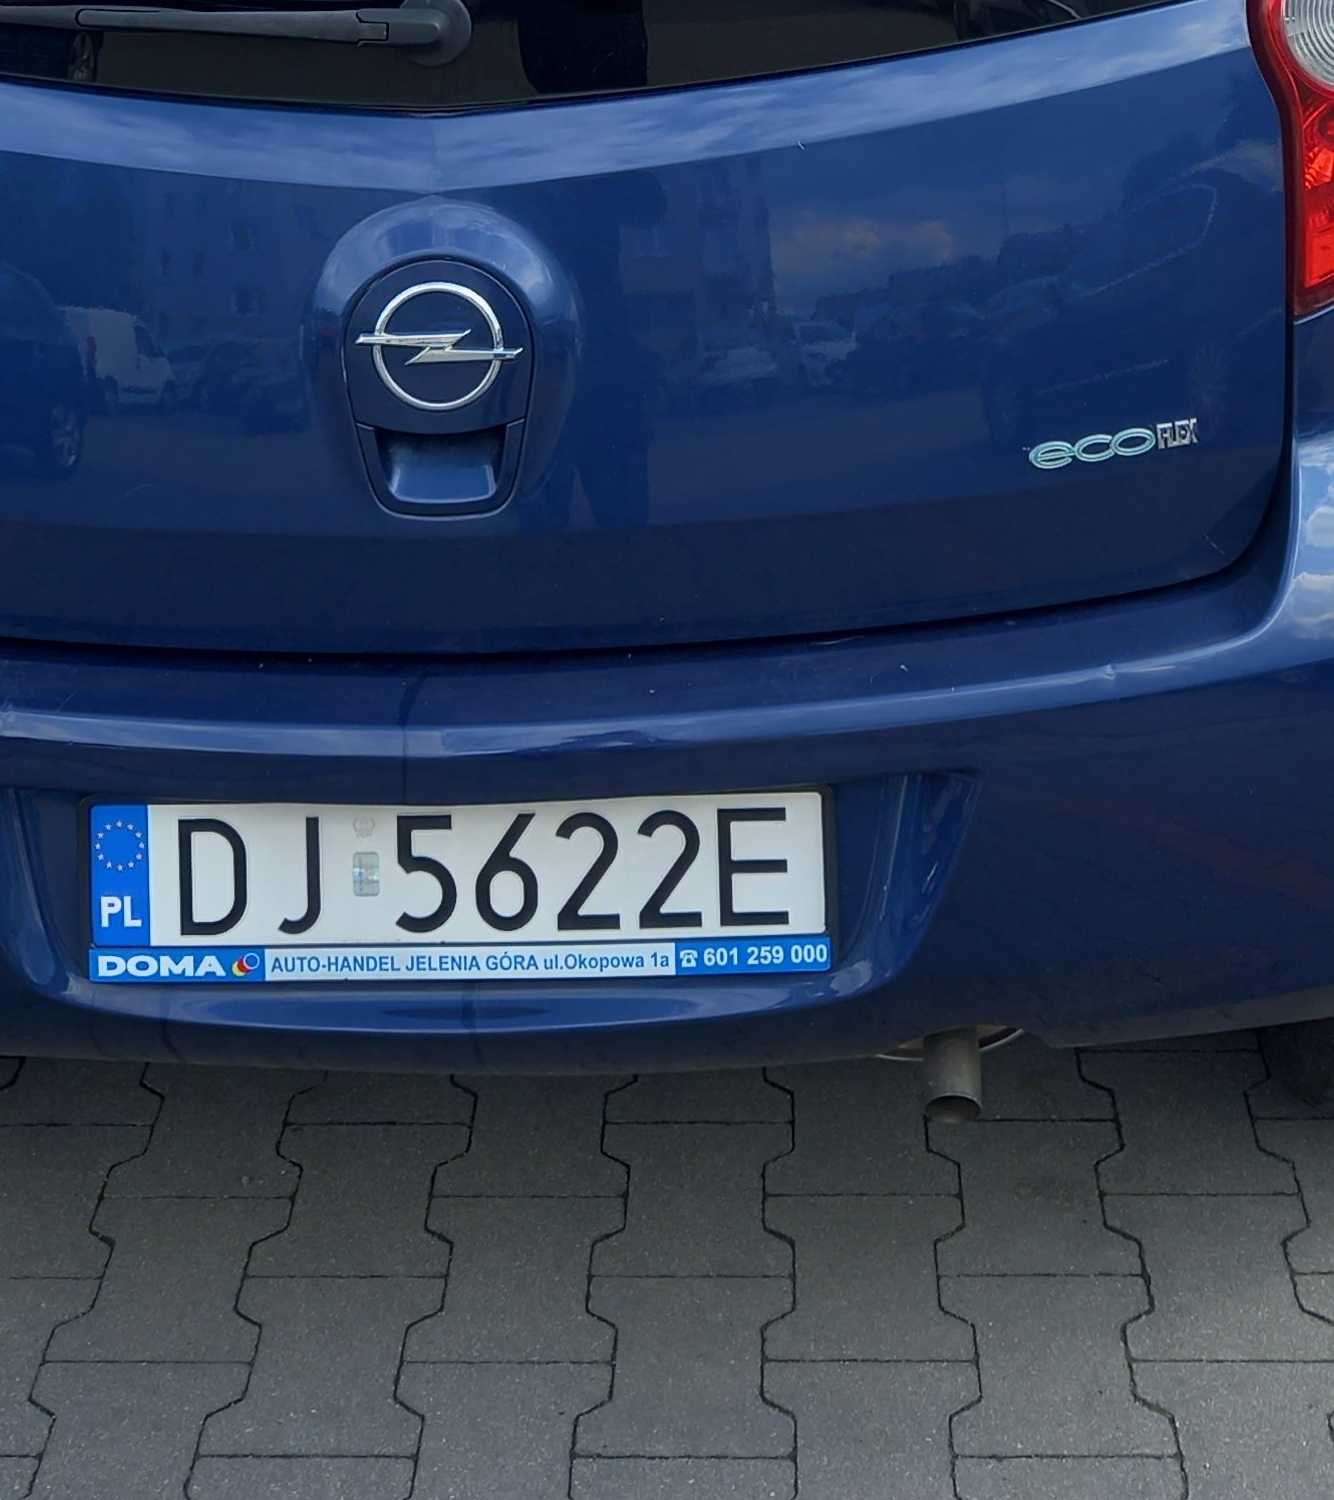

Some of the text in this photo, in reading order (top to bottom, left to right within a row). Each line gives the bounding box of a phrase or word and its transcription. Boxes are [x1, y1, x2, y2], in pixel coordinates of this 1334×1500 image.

[178, 807, 790, 935] DJ 5622E
[100, 896, 142, 929] PL
[97, 954, 227, 978] DOMA
[271, 950, 669, 974] AUTO-HANDEL JELENIA GÓRA ul.Okopowa 1a
[703, 944, 828, 967] 601 259 000
